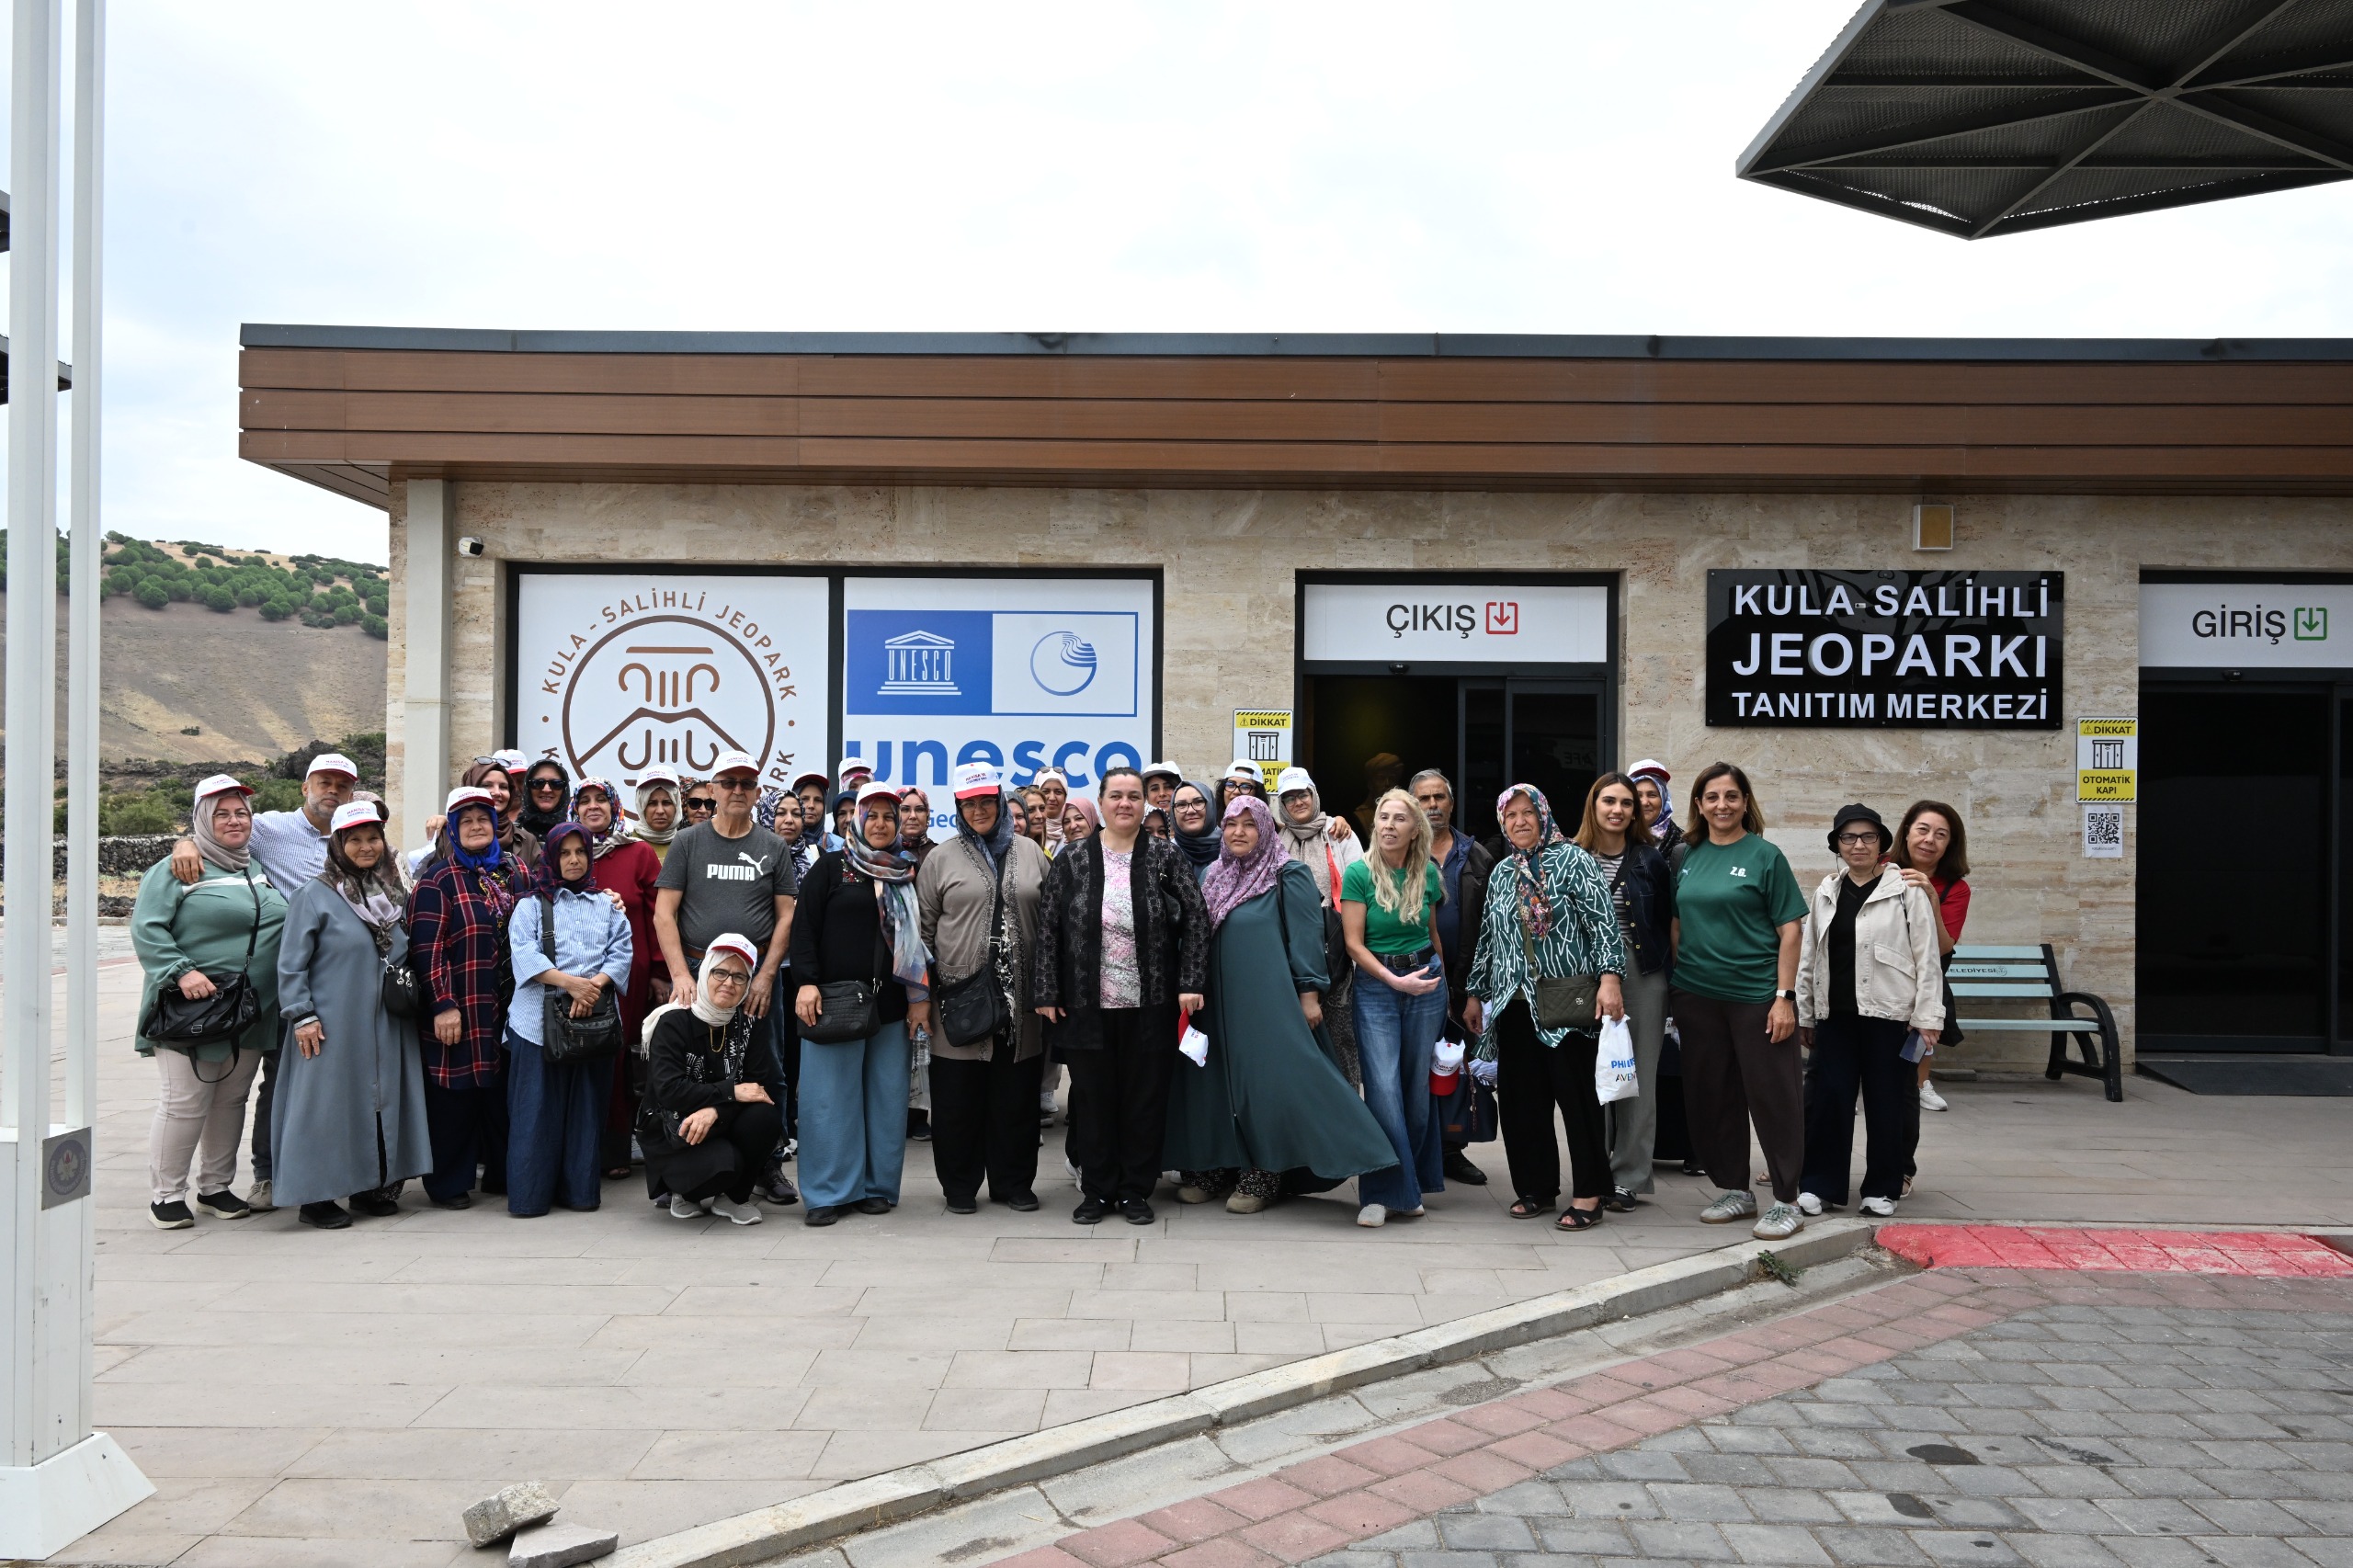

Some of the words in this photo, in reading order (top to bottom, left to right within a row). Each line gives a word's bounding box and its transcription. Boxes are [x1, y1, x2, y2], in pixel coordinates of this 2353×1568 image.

[1386, 604, 1476, 639] ÇIKIŞ
[2192, 604, 2286, 645] GİRİŞ
[541, 634, 587, 695] KULA
[601, 587, 707, 623] SALİHLİ
[715, 605, 797, 700] JEOPARK
[1732, 632, 2046, 678] JEOPARKI
[888, 649, 951, 681] UNESCO
[1732, 691, 1875, 718] TANITIM
[1887, 687, 2047, 720] MERKEZİ
[1250, 717, 1287, 726] DİKKAT
[2094, 723, 2131, 734] DİKKAT
[2083, 775, 2131, 784] OTOMATİK
[707, 864, 755, 881] PUMA
